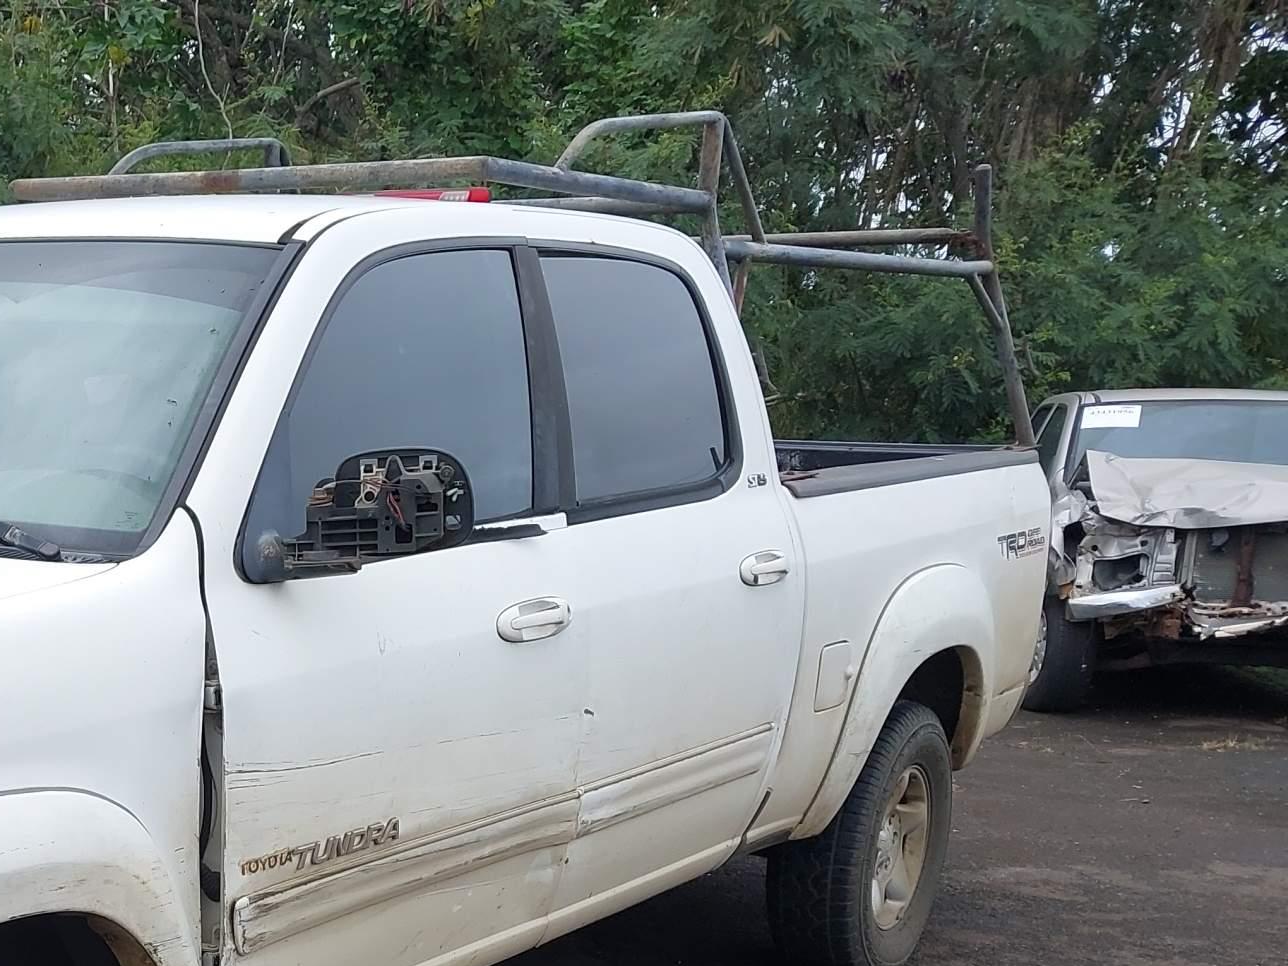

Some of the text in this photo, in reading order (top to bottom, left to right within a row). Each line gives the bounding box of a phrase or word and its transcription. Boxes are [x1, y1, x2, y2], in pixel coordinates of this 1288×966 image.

[997, 531, 1027, 560] TRD
[239, 816, 400, 876] TOYOTA TUNDRA
